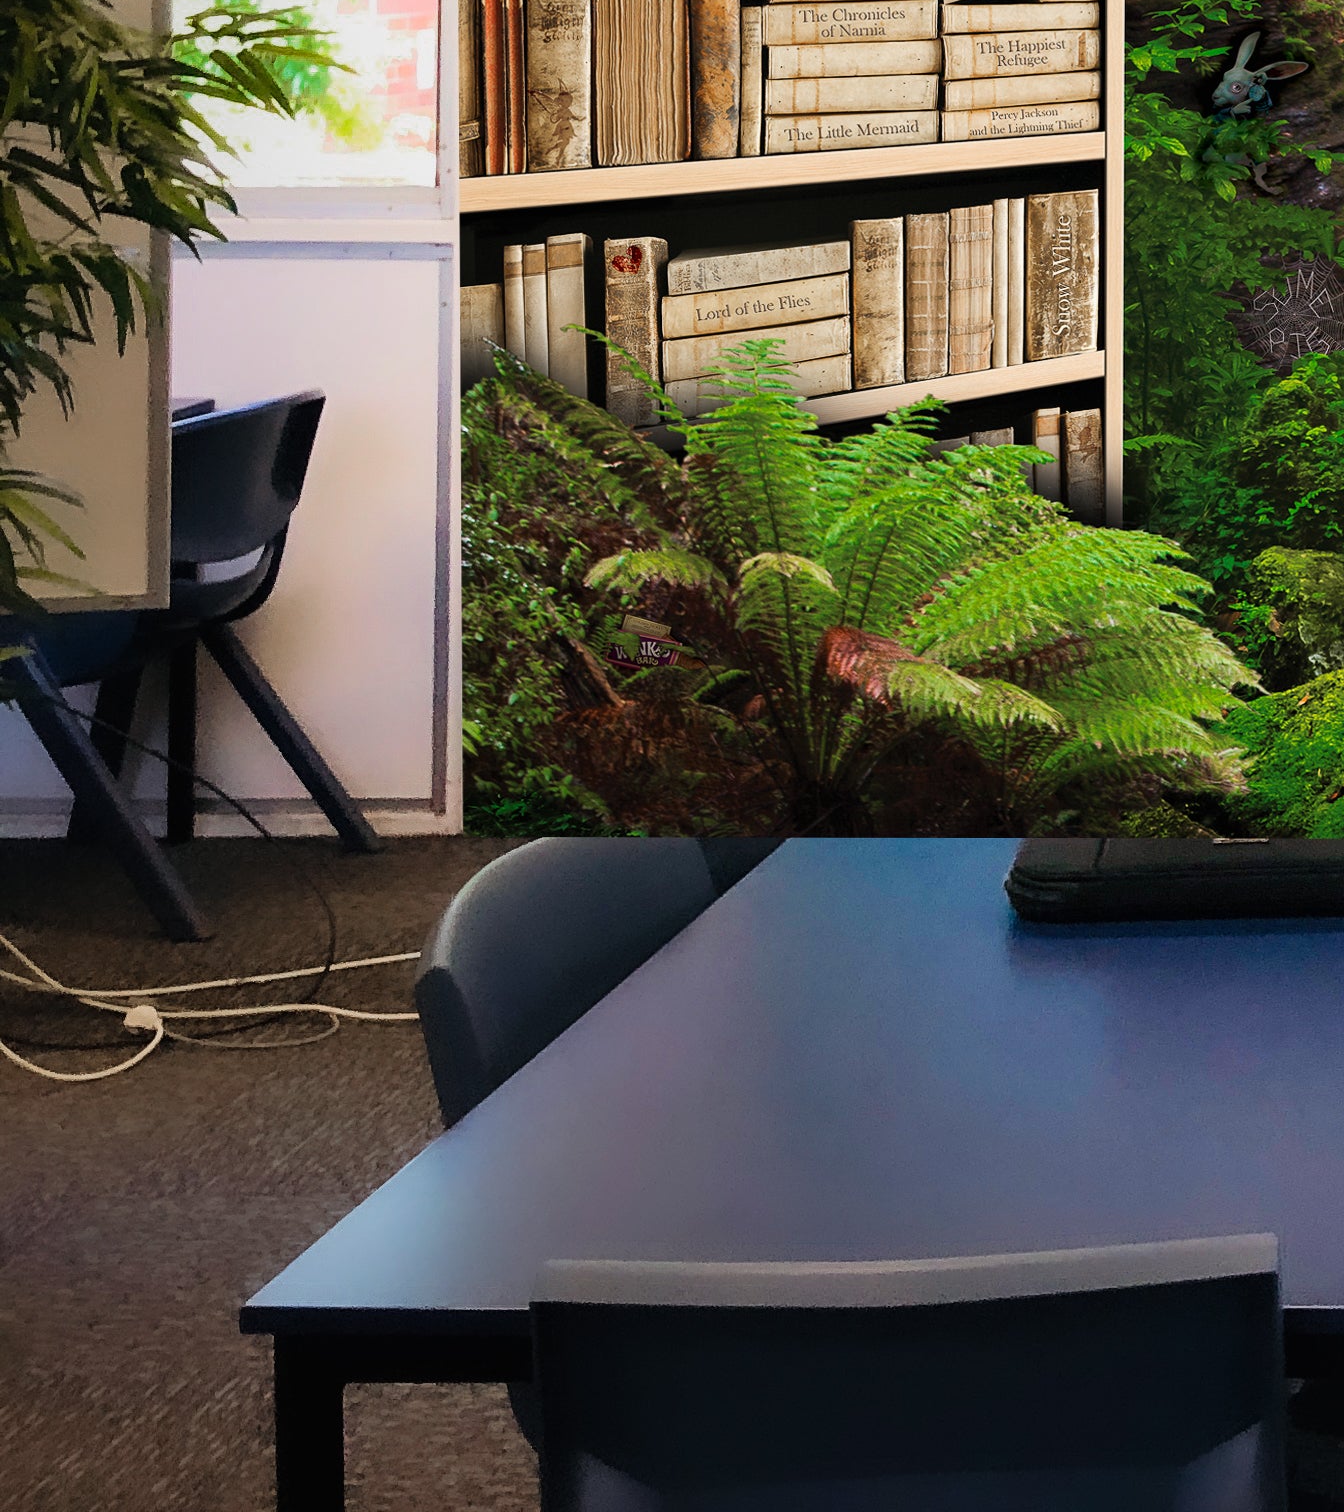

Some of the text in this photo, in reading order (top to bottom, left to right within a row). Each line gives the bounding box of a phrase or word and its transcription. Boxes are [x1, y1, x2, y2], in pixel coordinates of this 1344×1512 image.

[799, 7, 905, 23] The Chronicles
[821, 23, 886, 37] of Narnia
[976, 38, 1066, 54] The Happiest
[997, 55, 1048, 67] Refugee
[992, 108, 1058, 121] Percy Jackson
[784, 120, 919, 141] The Little Mermaid
[969, 119, 1084, 136] and the Lightning Thief
[1052, 215, 1071, 337] Snow White
[696, 295, 811, 321] Lord of the Flies
